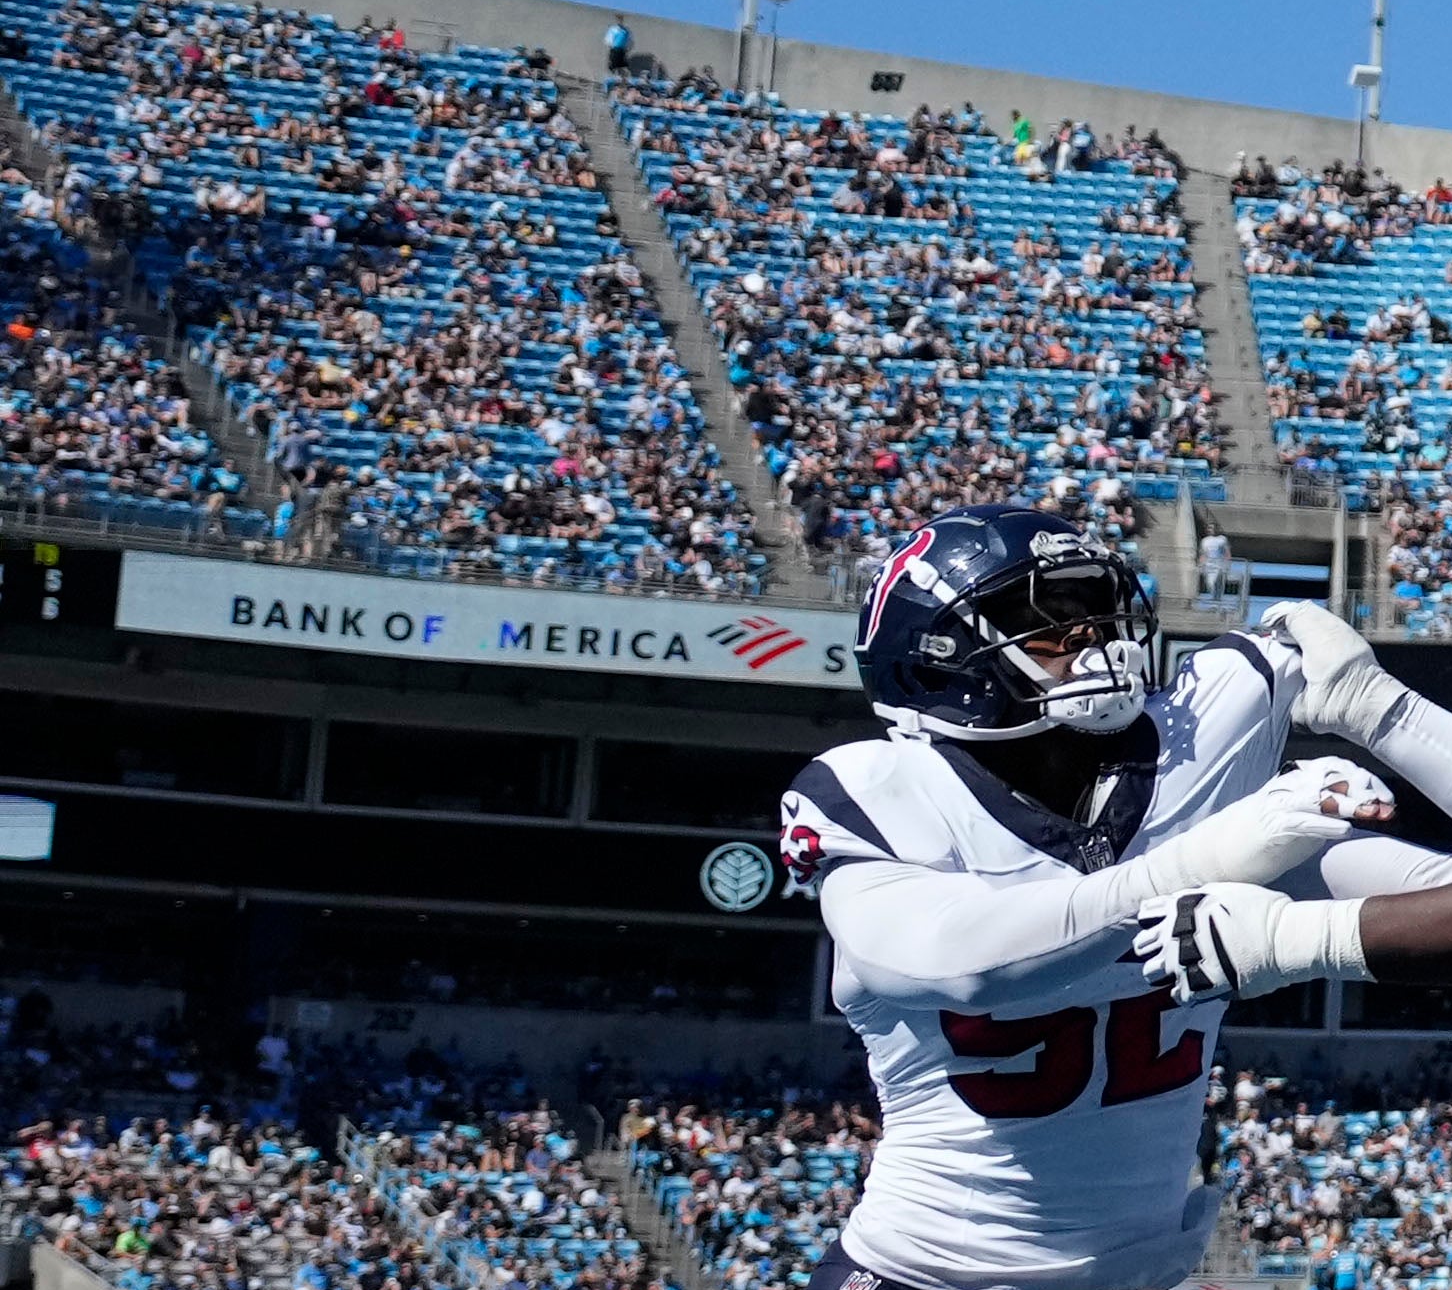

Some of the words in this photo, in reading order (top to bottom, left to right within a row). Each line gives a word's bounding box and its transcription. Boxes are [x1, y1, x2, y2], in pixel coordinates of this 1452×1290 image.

[230, 594, 366, 638] BANK
[384, 612, 445, 645] OF
[500, 621, 692, 663] MERICA
